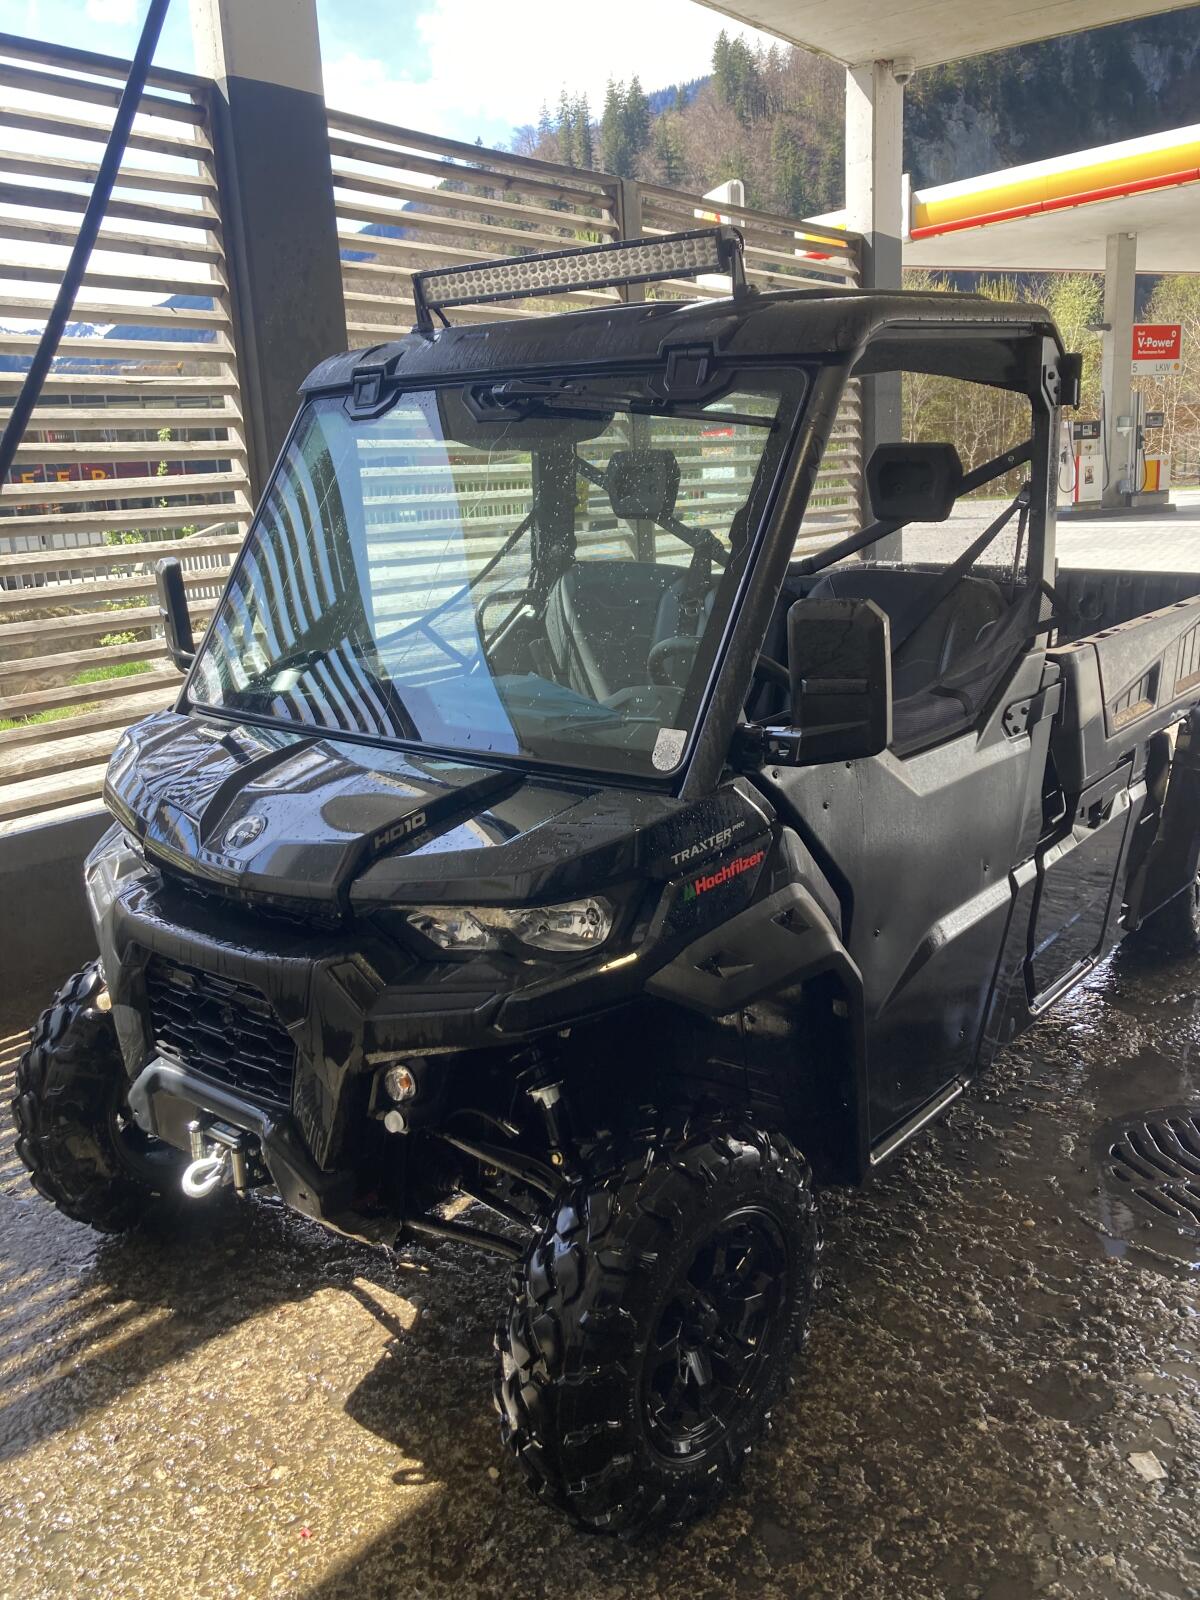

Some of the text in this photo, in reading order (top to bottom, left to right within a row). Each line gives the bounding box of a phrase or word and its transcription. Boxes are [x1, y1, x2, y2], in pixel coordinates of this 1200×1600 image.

[1138, 337, 1174, 347] V-Power
[1132, 363, 1170, 373] 5 LKW
[373, 812, 426, 849] HD10
[671, 821, 745, 864] TRAXTER PRO
[694, 850, 765, 896] Hochfilzer
